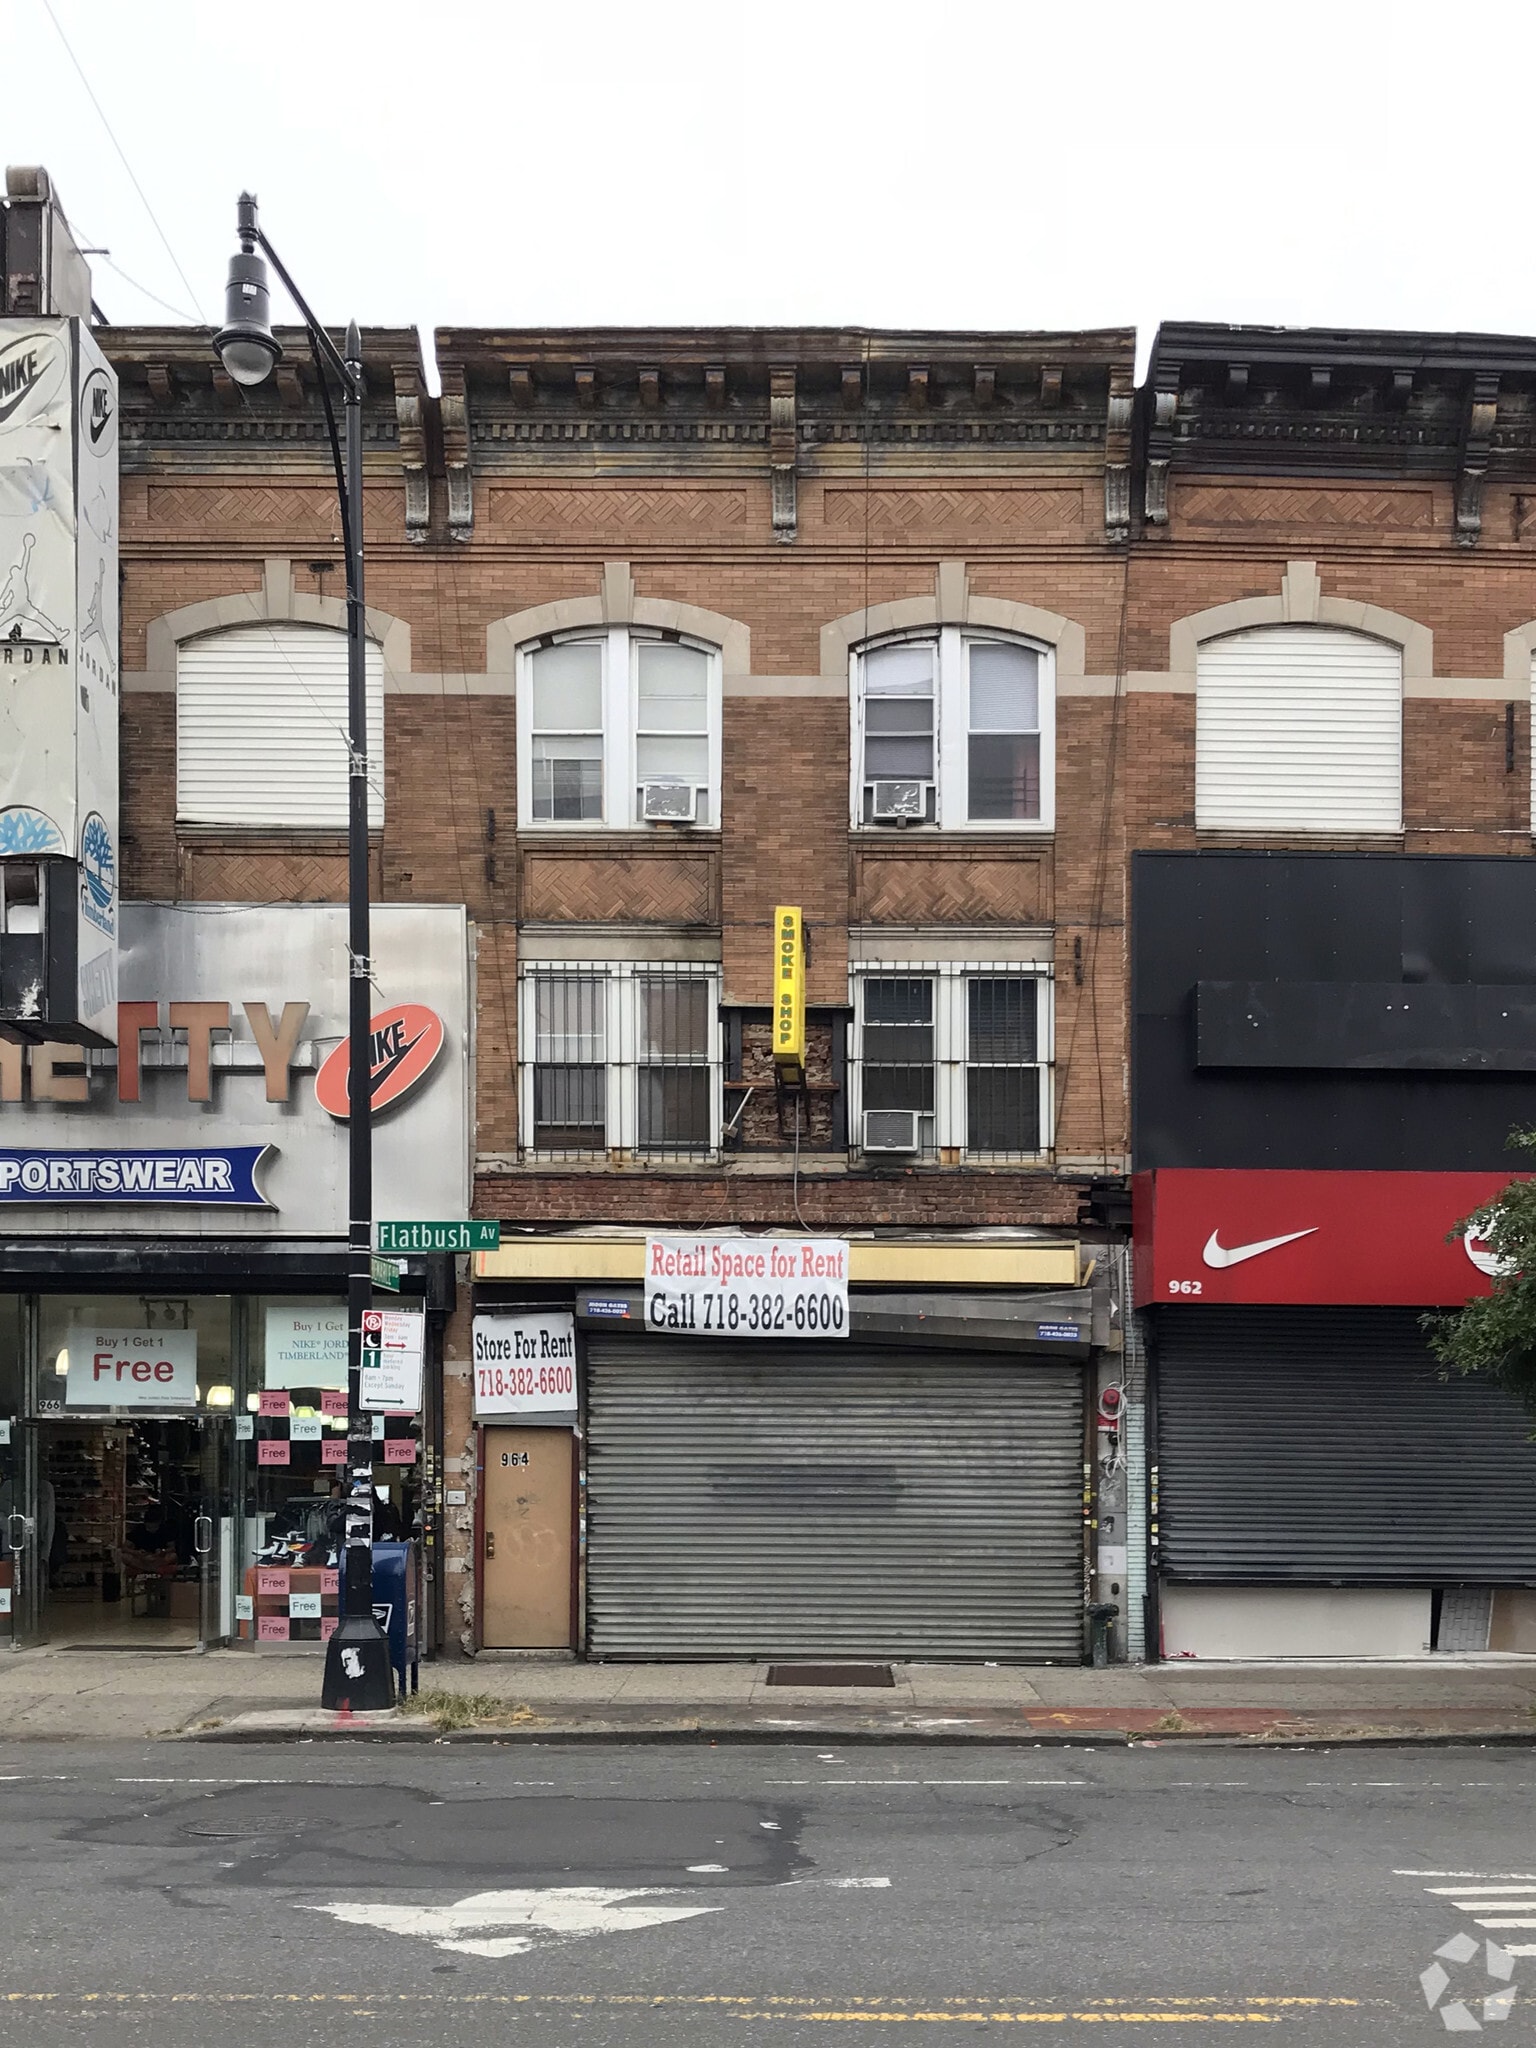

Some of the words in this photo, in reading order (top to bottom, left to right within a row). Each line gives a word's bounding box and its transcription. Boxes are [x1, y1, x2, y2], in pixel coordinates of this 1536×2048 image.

[0, 349, 37, 400] NIKE
[92, 387, 108, 417] NIKE
[4, 648, 69, 664] RDAN
[781, 916, 795, 979] SMOKE
[779, 994, 793, 1044] SHOP
[370, 1018, 406, 1067] IKE
[0, 1157, 235, 1193] PORTSWEAR
[380, 1224, 470, 1248] Flatbush
[480, 1226, 495, 1240] Av
[651, 1244, 706, 1276] Retail
[711, 1245, 765, 1286] Space
[770, 1245, 797, 1278] for
[801, 1246, 843, 1278] Rent
[1169, 1280, 1202, 1294] 962
[651, 1292, 696, 1329] Call
[703, 1293, 843, 1330] 718-382-6600
[293, 1322, 313, 1334] Buy
[325, 1321, 343, 1331] Get
[96, 1337, 118, 1348] Buy
[123, 1338, 128, 1346] 1
[133, 1337, 153, 1347] Get
[158, 1338, 163, 1346] 1
[476, 1332, 511, 1361] Store
[514, 1331, 537, 1359] For
[540, 1330, 572, 1358] Rent
[369, 1351, 375, 1367] 1
[93, 1353, 174, 1382] Free
[479, 1366, 572, 1397] 718-382-6600
[39, 1400, 60, 1410] 966
[262, 1400, 286, 1410] Free
[325, 1400, 348, 1410] Free
[238, 1423, 251, 1433] Free
[293, 1425, 317, 1434] Free
[262, 1448, 286, 1458] Free
[326, 1448, 348, 1458] Free
[388, 1447, 412, 1457] Free
[501, 1453, 529, 1466] 964
[261, 1578, 286, 1588] Free
[324, 1577, 339, 1588] Fre
[237, 1602, 251, 1613] Free
[292, 1601, 317, 1611] Free
[261, 1624, 285, 1634] Free
